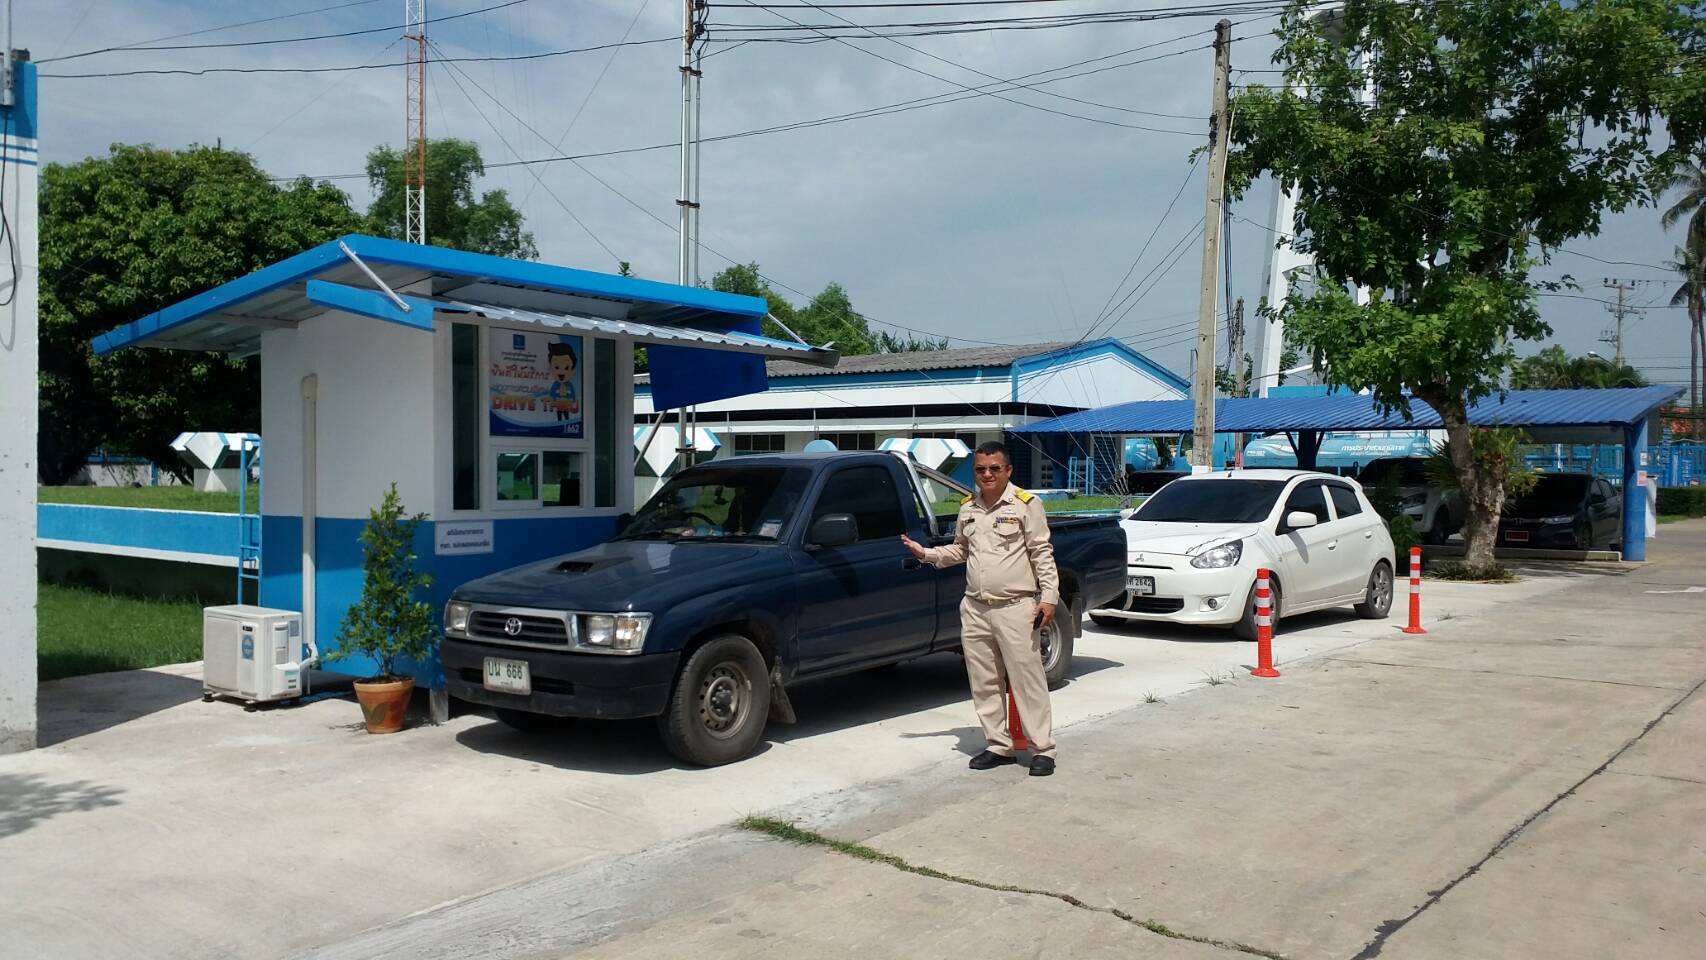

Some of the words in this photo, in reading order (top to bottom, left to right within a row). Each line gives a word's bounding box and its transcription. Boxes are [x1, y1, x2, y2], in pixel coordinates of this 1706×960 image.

[491, 395, 537, 412] DRIVE
[563, 423, 580, 434] 1662
[506, 663, 523, 680] 666
